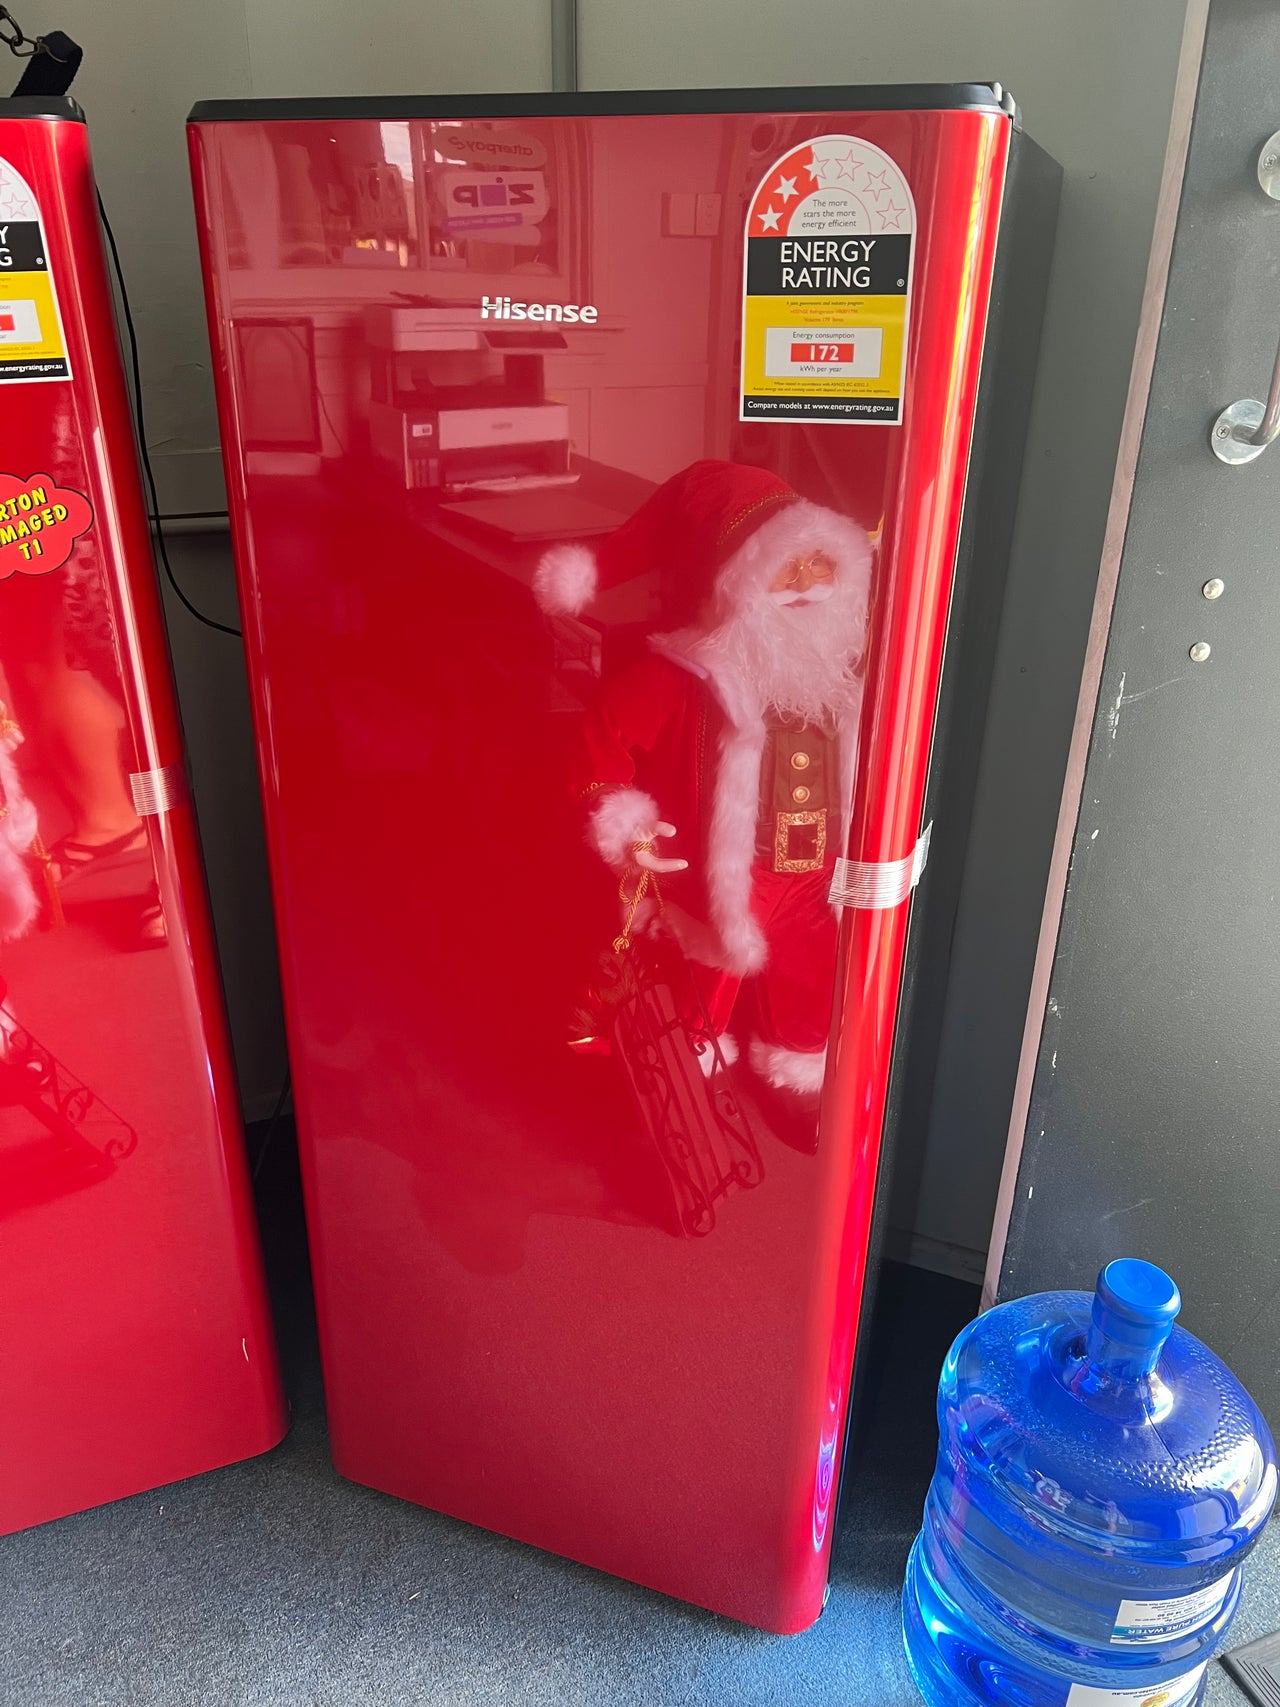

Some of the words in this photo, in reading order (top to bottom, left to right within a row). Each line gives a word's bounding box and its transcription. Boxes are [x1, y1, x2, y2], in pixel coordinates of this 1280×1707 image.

[812, 199, 826, 208] The
[822, 209, 834, 217] the
[801, 221, 826, 230] energy
[828, 219, 857, 228] efficient
[780, 240, 877, 263] ENERGY
[781, 266, 871, 289] RATING
[481, 296, 599, 324] Hisense
[792, 331, 813, 340] Energy
[815, 331, 855, 340] consumption
[810, 344, 839, 361] 172
[829, 366, 842, 374] year
[747, 400, 778, 411] Compare
[779, 401, 803, 410] models
[812, 403, 895, 414] www.energyrating.gov.au
[1127, 1626, 1164, 1635] WATER
